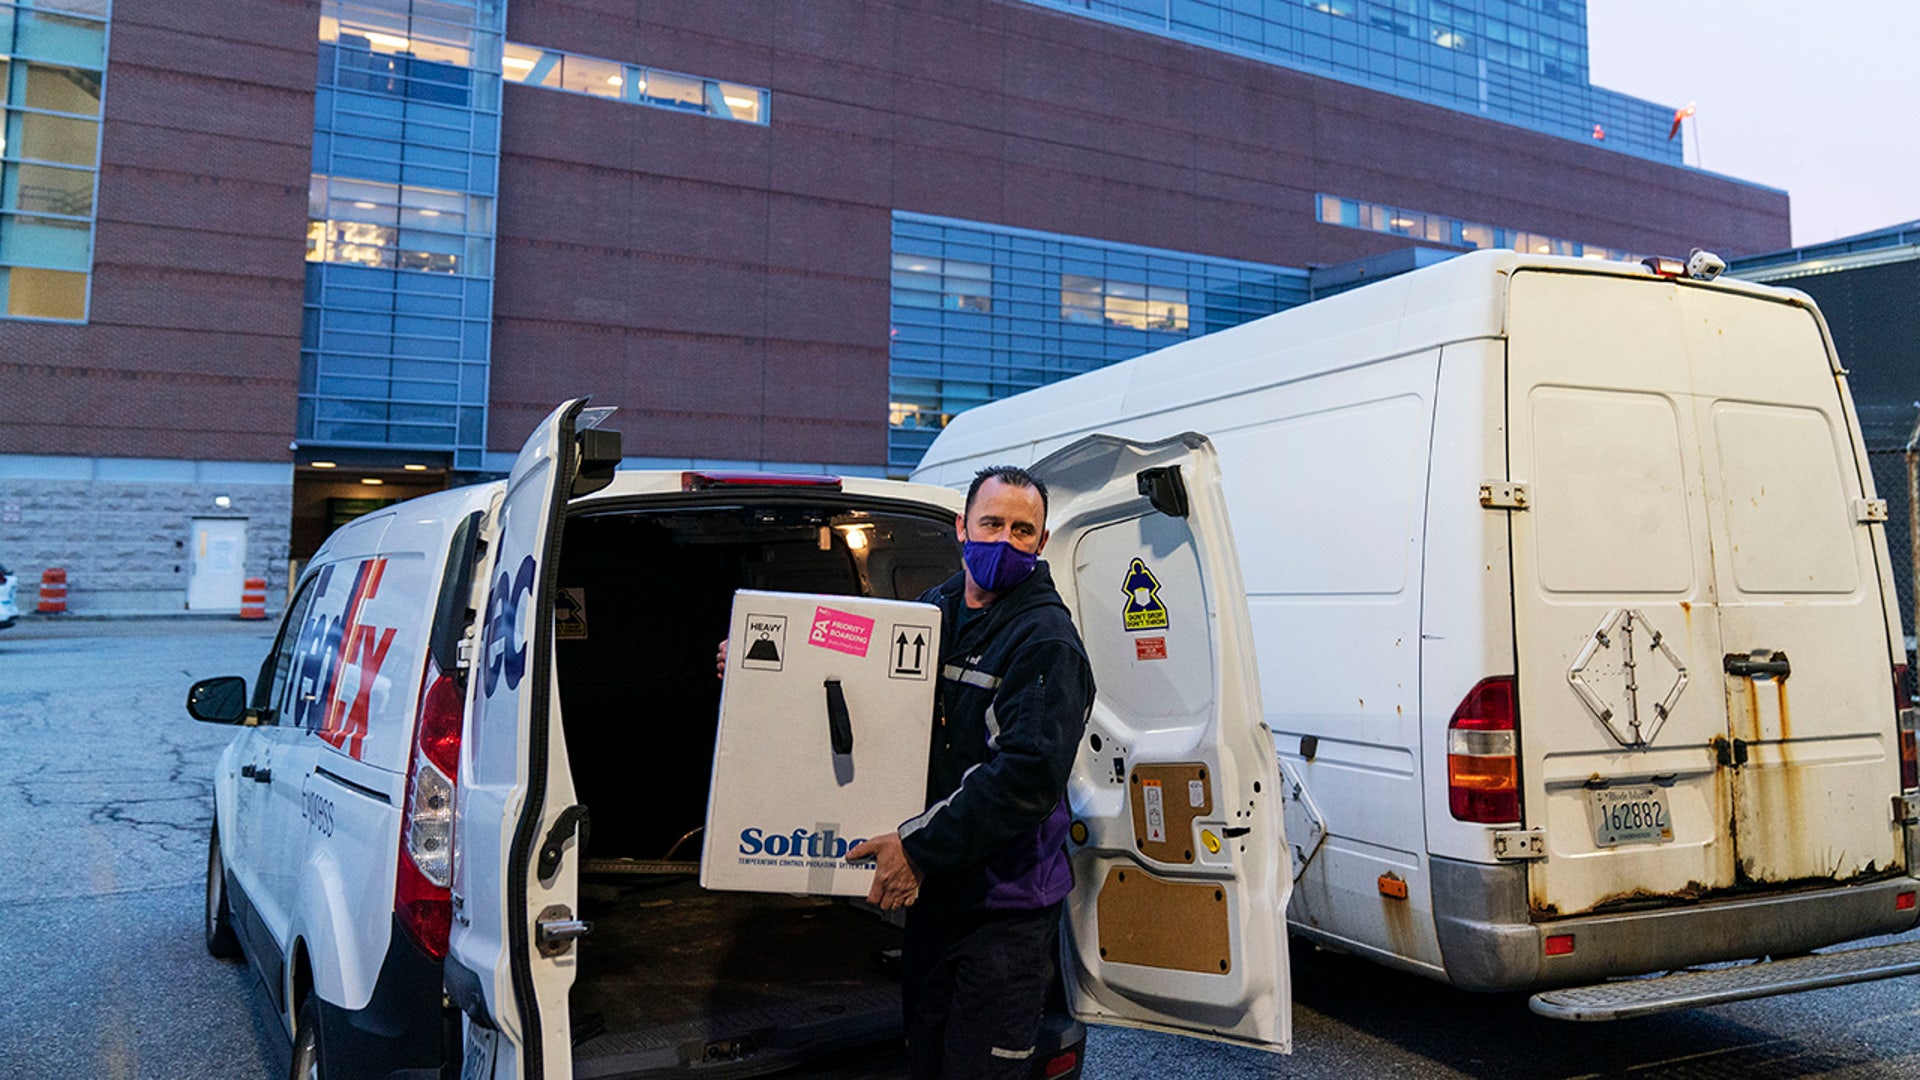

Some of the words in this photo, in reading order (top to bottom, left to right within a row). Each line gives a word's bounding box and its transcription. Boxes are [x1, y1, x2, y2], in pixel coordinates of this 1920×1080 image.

[750, 622, 782, 632] HEAVY
[811, 620, 830, 642] PA
[831, 620, 866, 634] PRIORITY
[829, 629, 868, 645] BOARDING
[1601, 801, 1665, 831] 162882
